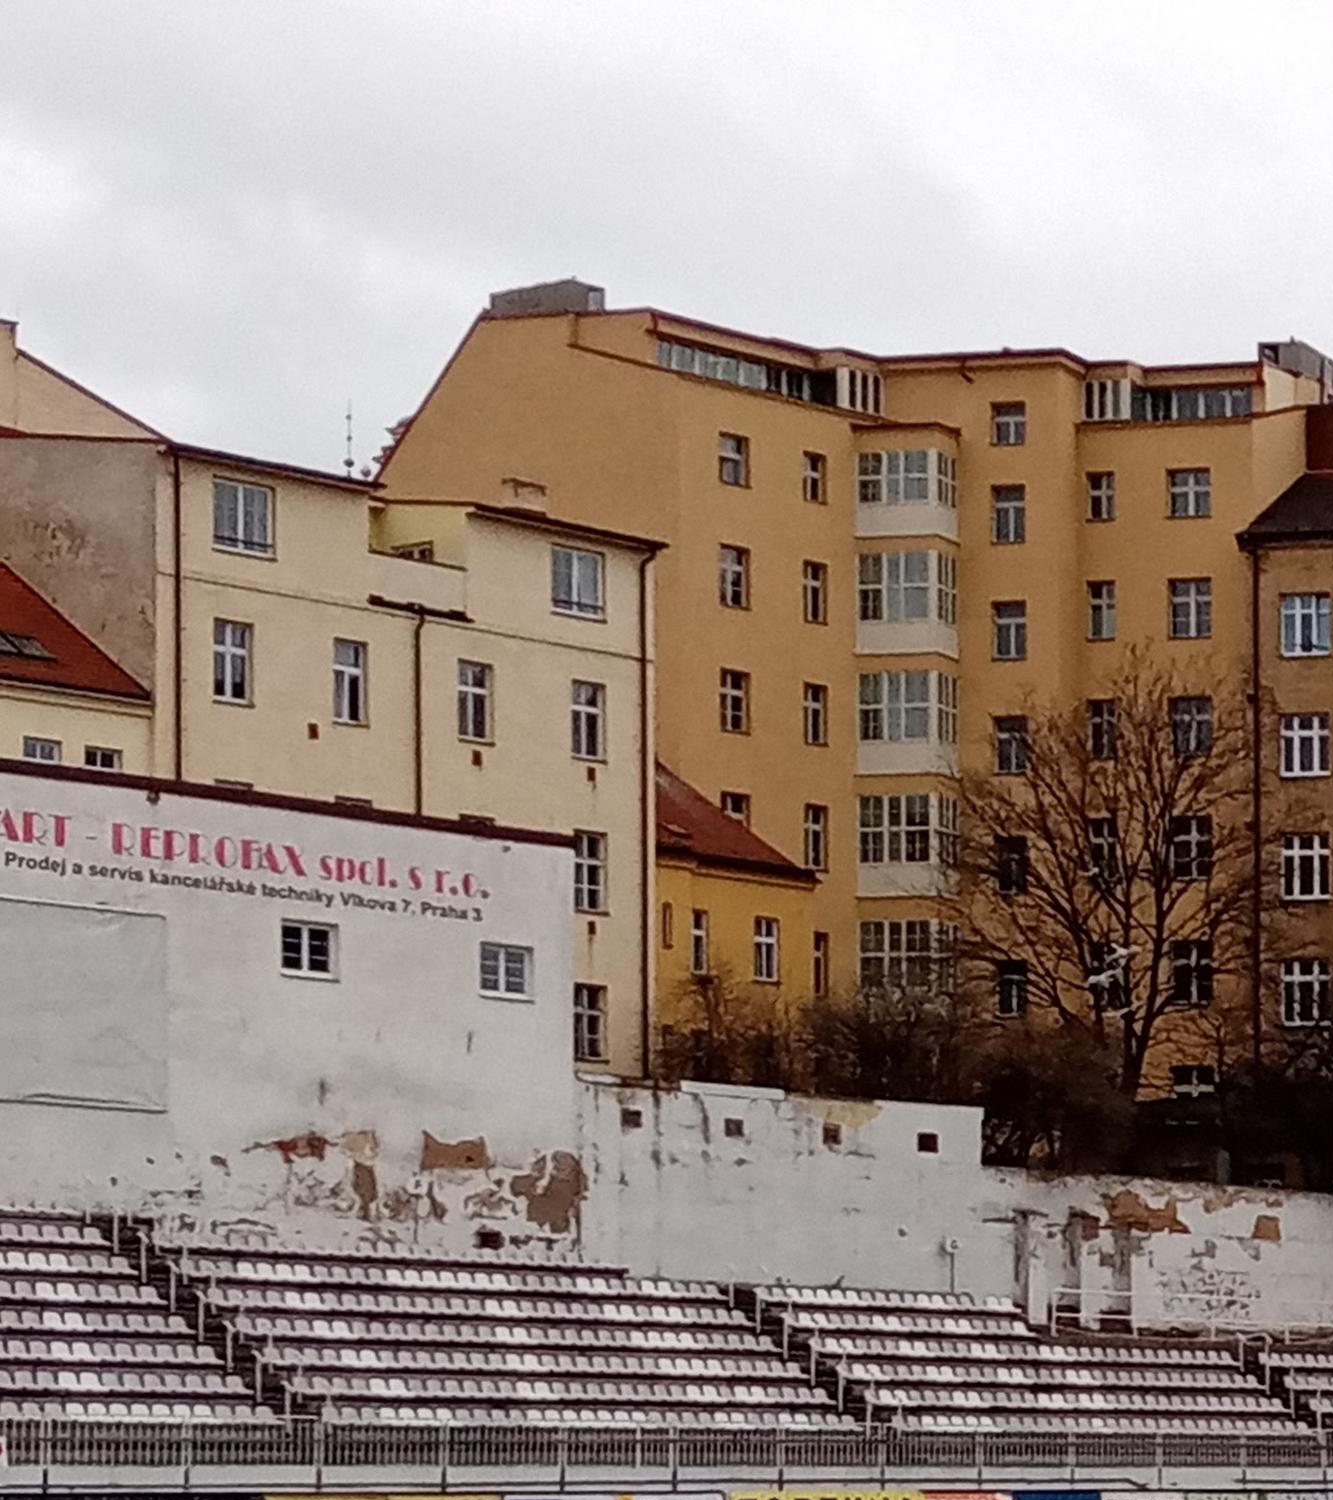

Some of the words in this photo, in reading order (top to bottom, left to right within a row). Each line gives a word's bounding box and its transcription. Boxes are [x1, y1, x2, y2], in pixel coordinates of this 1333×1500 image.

[111, 823, 307, 877] REPROFAX
[4, 851, 67, 877] Prodej
[72, 862, 84, 875] a
[89, 864, 144, 882] servis
[262, 883, 335, 908] techniky
[421, 901, 468, 920] Praha
[472, 908, 484, 922] 3
